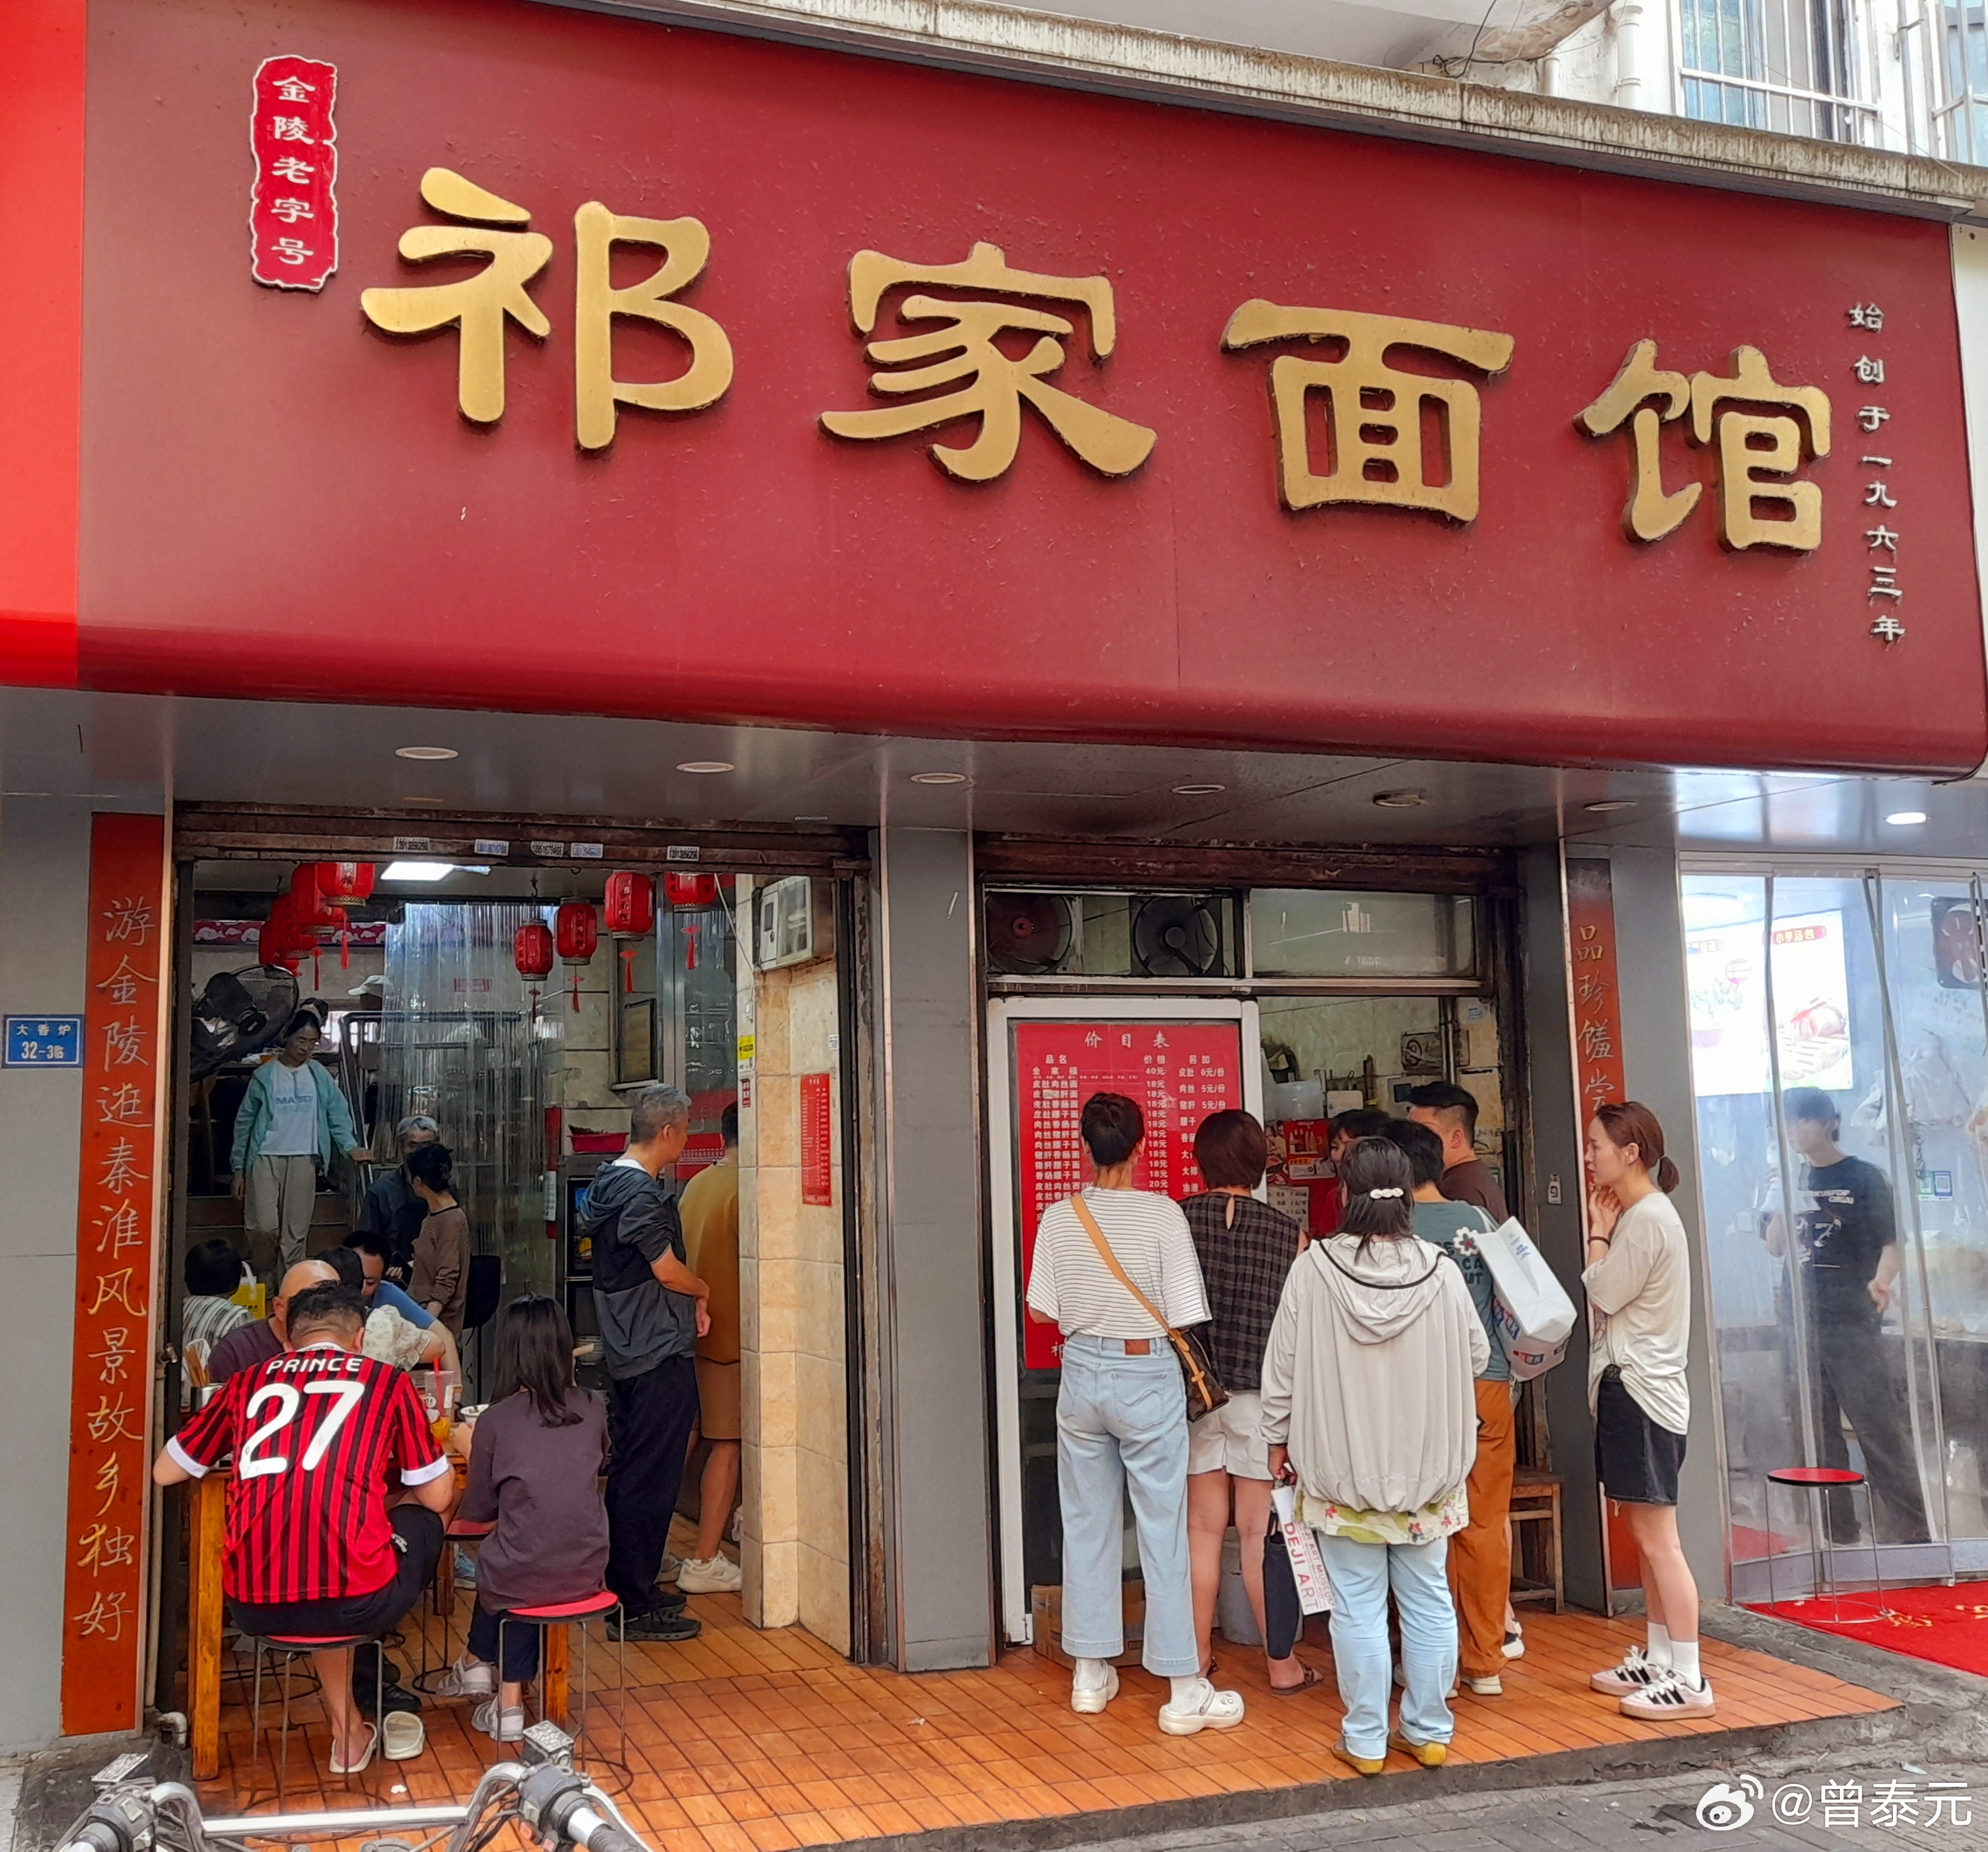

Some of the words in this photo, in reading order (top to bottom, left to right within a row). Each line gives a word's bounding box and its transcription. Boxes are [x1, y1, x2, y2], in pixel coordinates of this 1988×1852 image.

[271, 76, 315, 265] 金陵老字号
[360, 167, 1833, 553] 祁家面馆
[1848, 302, 1905, 642] 始创于一九六三年
[16, 1024, 71, 1036] 大香炉
[1084, 1030, 1170, 1049] 价目表
[1045, 1054, 1067, 1064] 品名
[1143, 1054, 1166, 1064] 价格
[1188, 1054, 1210, 1064] 另加
[1032, 1067, 1078, 1075] 全家福
[1145, 1067, 1166, 1075] 40元
[1179, 1068, 1195, 1077] 皮肚
[1032, 1080, 1078, 1088] 皮肚肉丝面
[1146, 1080, 1165, 1088] 18元
[1179, 1084, 1195, 1094] 肉丝
[1201, 1084, 1225, 1094] 5元/份
[1033, 1090, 1078, 1098] 皮猪肝面
[1146, 1090, 1166, 1098] 18元
[1033, 1100, 1079, 1109] 皮肚香肠面
[1146, 1100, 1166, 1108] 18元
[1180, 1101, 1195, 1110] 猪肝
[1201, 1101, 1226, 1110] 5元/份
[1033, 1110, 1079, 1119] 皮肚腰子面
[1147, 1110, 1166, 1118] 18元
[1034, 1120, 1079, 1128] 肉丝香肠面
[1180, 1117, 1196, 1127] 腰子
[1034, 1130, 1079, 1139] 肉丝猪肝面
[1148, 1130, 1167, 1138] 18元
[1035, 1141, 1079, 1149] 肉丝腰子面
[1148, 1140, 1167, 1148] 18元
[1035, 1151, 1080, 1159] 猪肝香肠面
[1148, 1150, 1167, 1158] 18元
[1181, 1151, 1193, 1159] 大
[1035, 1161, 1080, 1169] 猪肝腰子面
[1149, 1161, 1168, 1169] 18元
[1035, 1172, 1080, 1180] 香肠腰子面
[1149, 1170, 1168, 1178] 18元
[1149, 1180, 1169, 1188] 20元
[72, 896, 157, 1641] 游金陵逛秦淮风景故乡独好
[266, 1358, 363, 1375] PRINCE
[239, 1380, 365, 1480] 27
[1284, 1522, 1306, 1566] DEJI
[1297, 1574, 1319, 1609] ART
